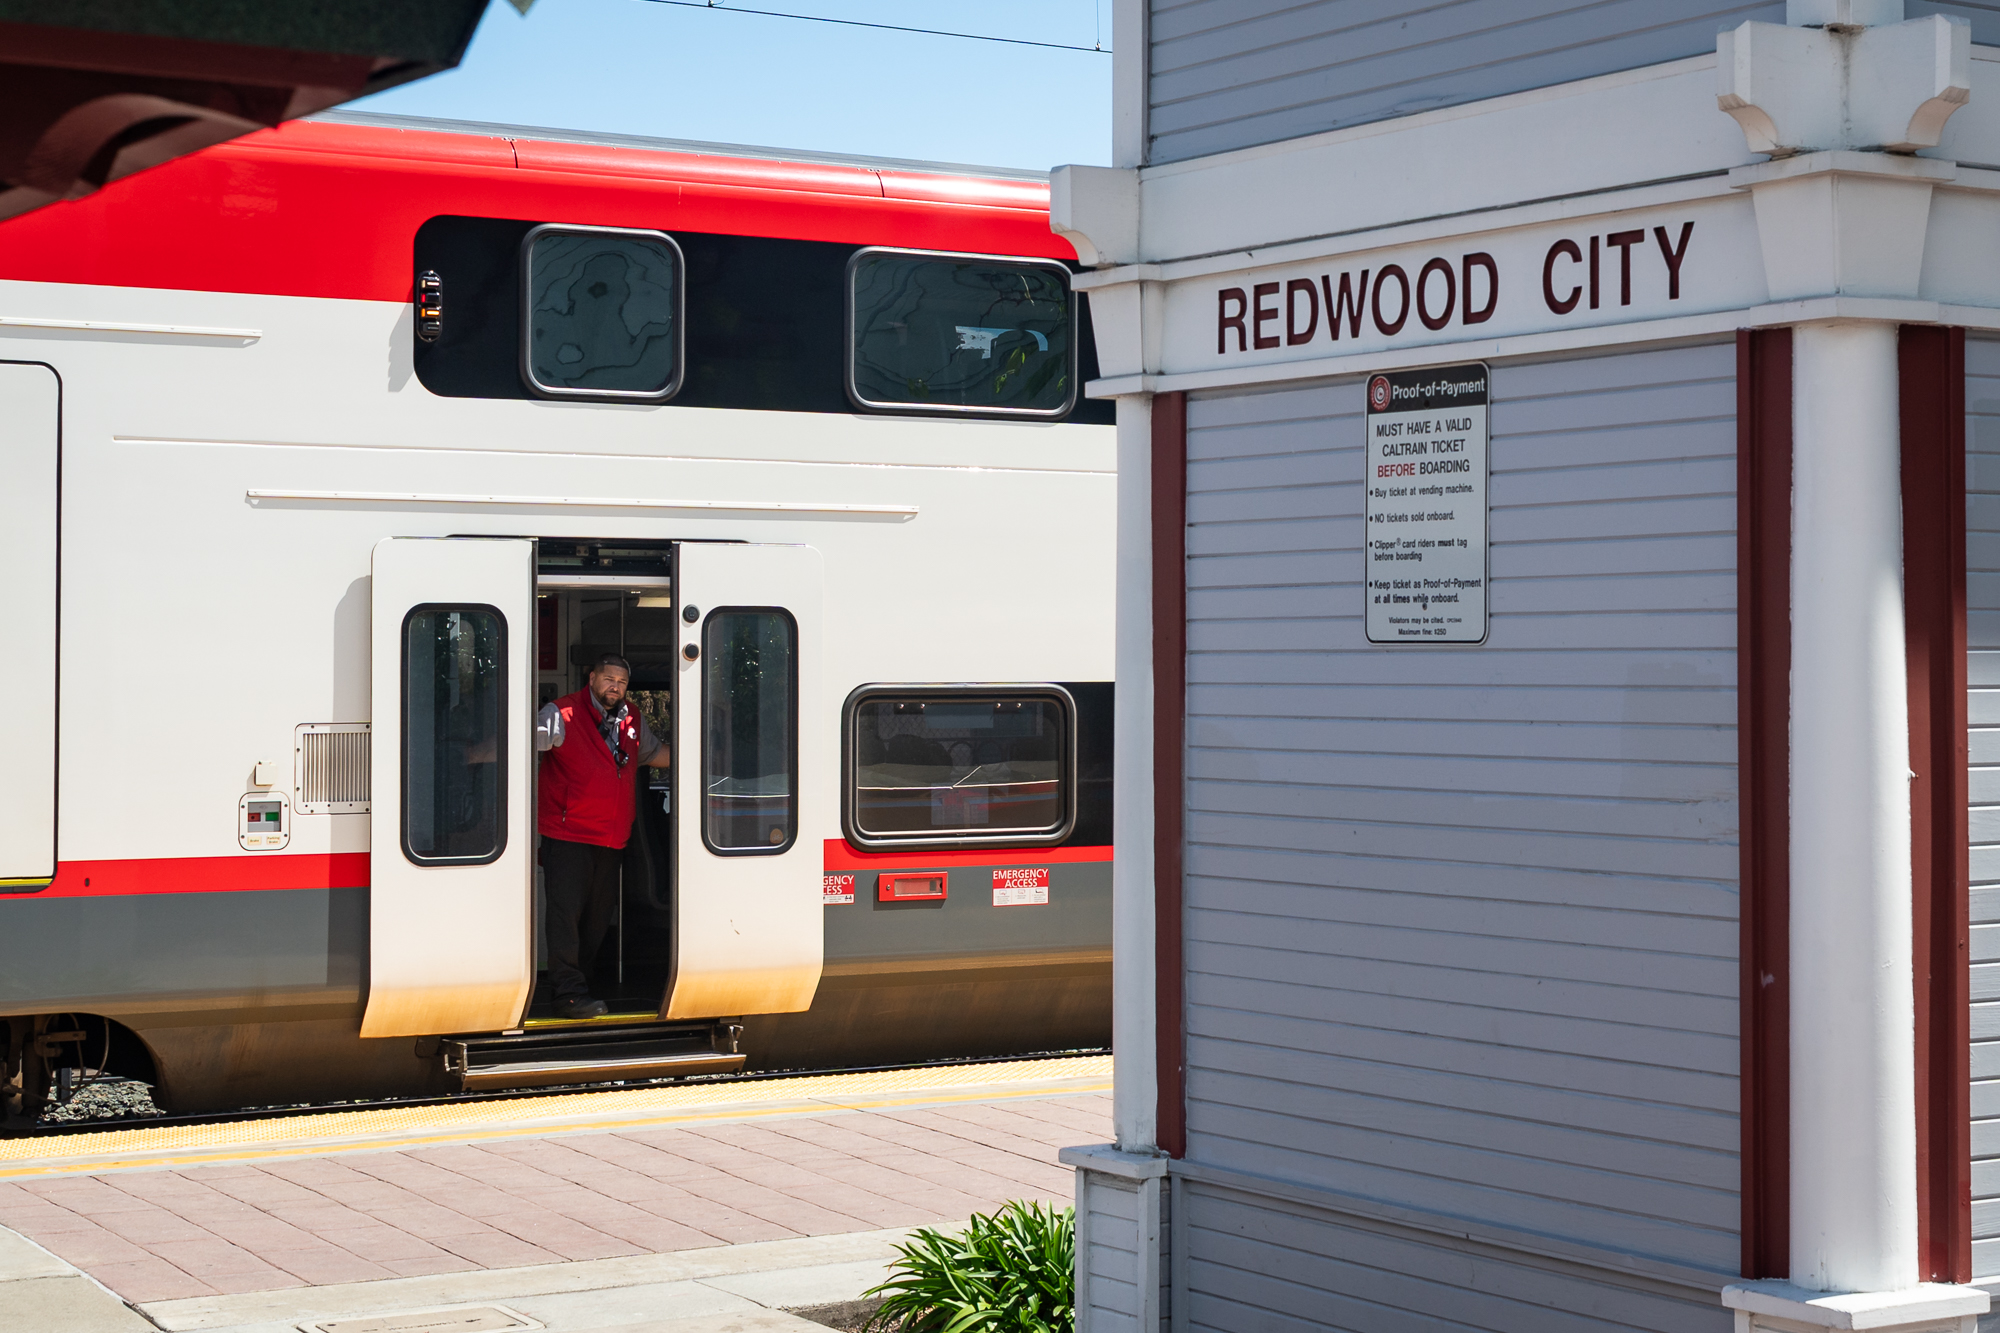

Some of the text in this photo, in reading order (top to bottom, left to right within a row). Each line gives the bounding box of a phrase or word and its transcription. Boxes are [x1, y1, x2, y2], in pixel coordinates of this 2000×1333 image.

[1217, 221, 1695, 355] REDWOOD CITY
[1392, 378, 1485, 399] Proof-of-Payment
[1376, 417, 1472, 437] MUST HAVE A VALID
[1382, 439, 1465, 457] CALTRAIN TICKET
[1377, 459, 1470, 478] BEFORE BOARDING
[1374, 483, 1474, 499] Buy ticket at vending machine.
[1374, 510, 1455, 523] NO tickets sold onboard.
[1402, 539, 1416, 549] card
[1417, 539, 1436, 548] riders
[1437, 538, 1455, 547] must
[1457, 538, 1468, 549] tag
[1374, 551, 1422, 562] before boarding
[1374, 578, 1482, 590] Keep ticket as Proof-of-Payment
[1374, 592, 1459, 604] at all times while onboard.
[1388, 616, 1410, 624] Violators
[1430, 616, 1445, 624] cited.
[1398, 628, 1421, 636] Maximum
[992, 868, 1049, 880] EMERGENCY
[1004, 878, 1038, 888] ACCESS
